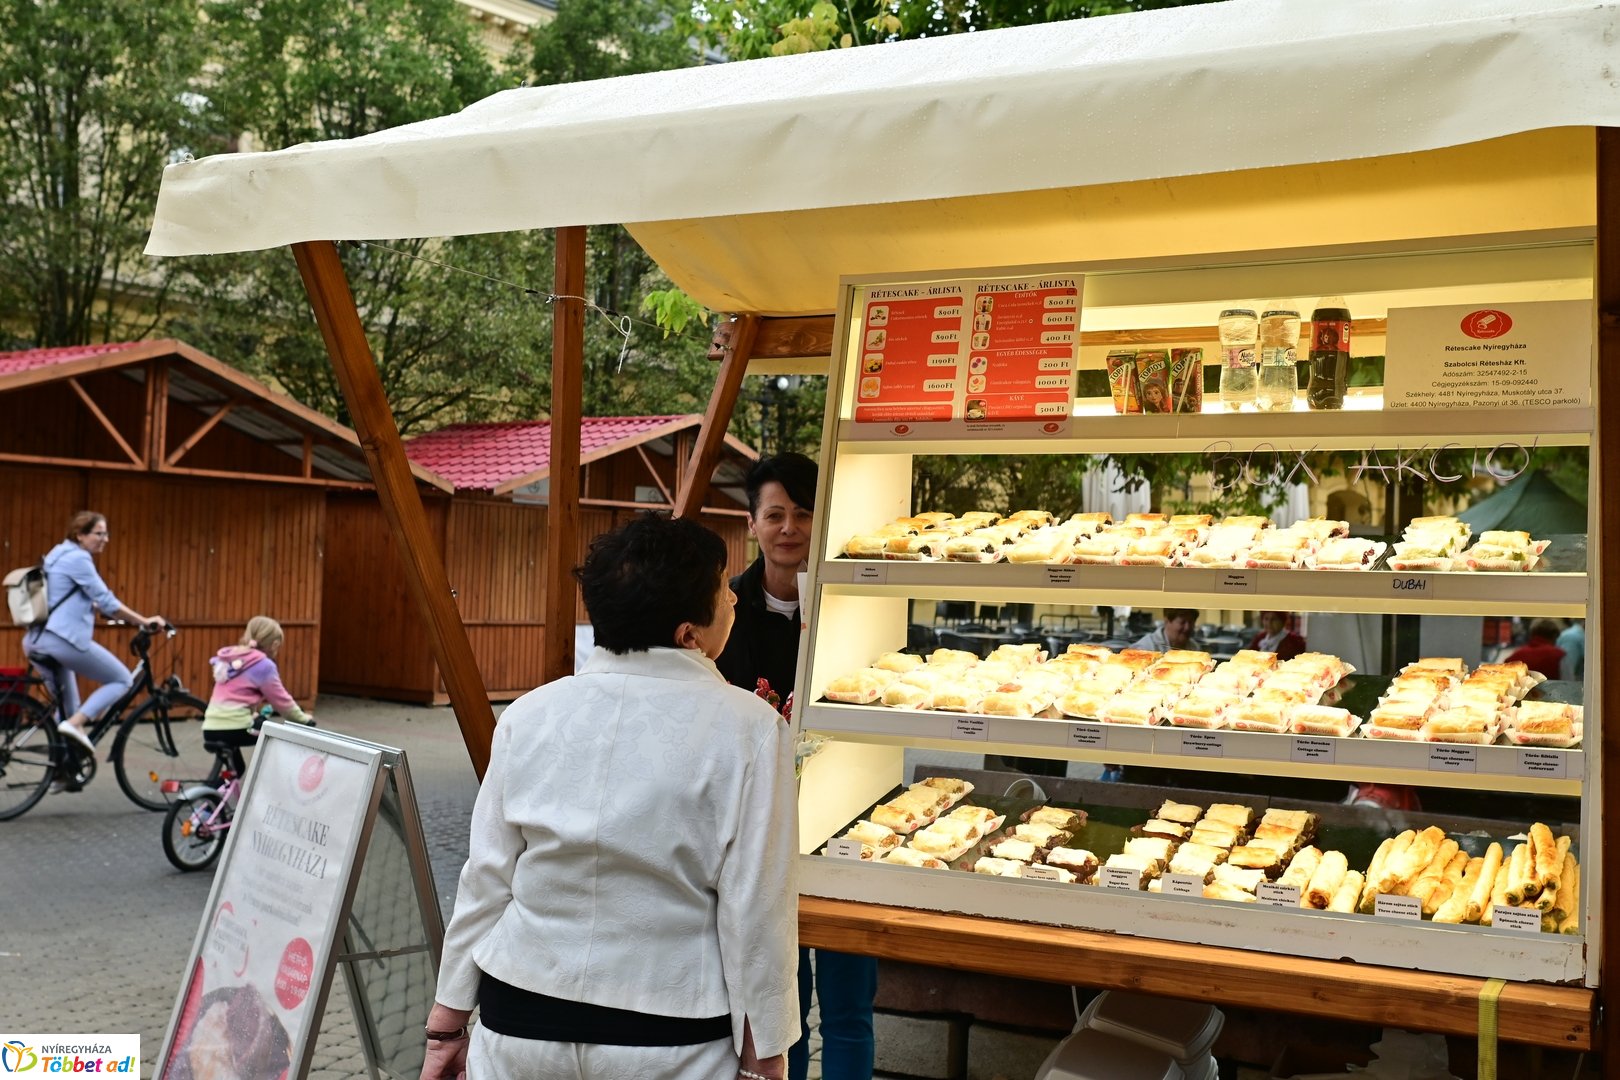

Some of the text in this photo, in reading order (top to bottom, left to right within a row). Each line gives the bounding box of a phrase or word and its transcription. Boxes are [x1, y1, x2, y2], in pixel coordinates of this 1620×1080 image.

[871, 289, 919, 298] RÉTESCAKE
[927, 286, 962, 295] ÁRLISTA
[977, 283, 1029, 292] RÉTESCAKE
[1037, 280, 1075, 288] ÁRLISTA
[1445, 343, 1527, 352] Rétescake Nyíregyháza
[1444, 360, 1478, 368] Szabolcsi
[1140, 361, 1163, 380] TOPJOY
[1202, 440, 1318, 490] BOX
[1392, 578, 1426, 590] DUBAI
